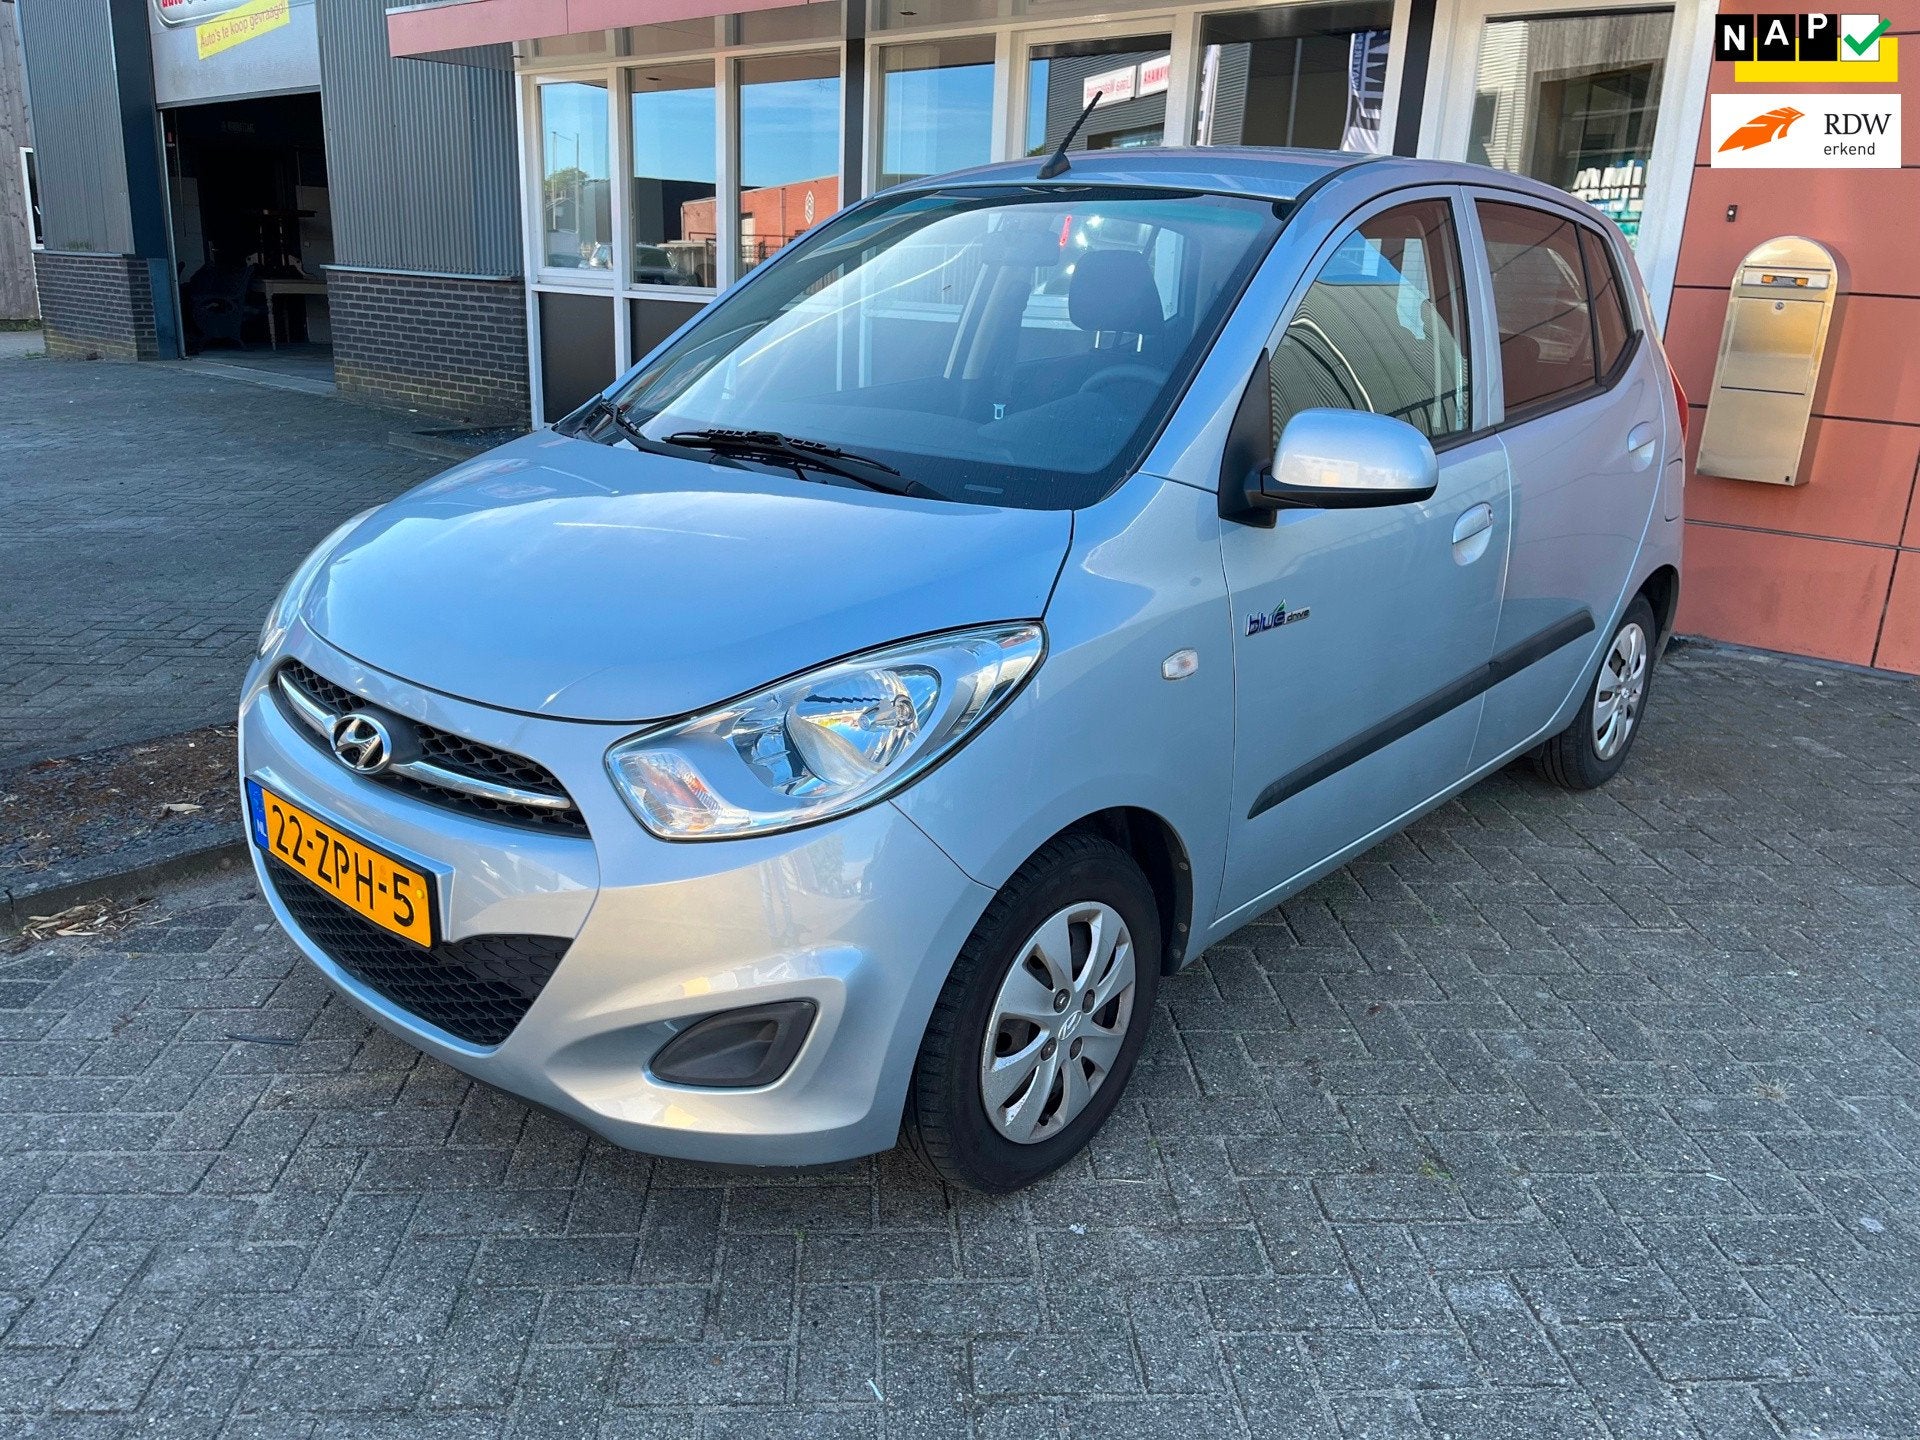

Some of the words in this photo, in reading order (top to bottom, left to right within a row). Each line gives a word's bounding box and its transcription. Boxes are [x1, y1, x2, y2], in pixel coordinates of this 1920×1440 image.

[229, 19, 248, 35] koop
[1245, 610, 1286, 636] blue
[272, 804, 415, 927] 22-ZPH-5
